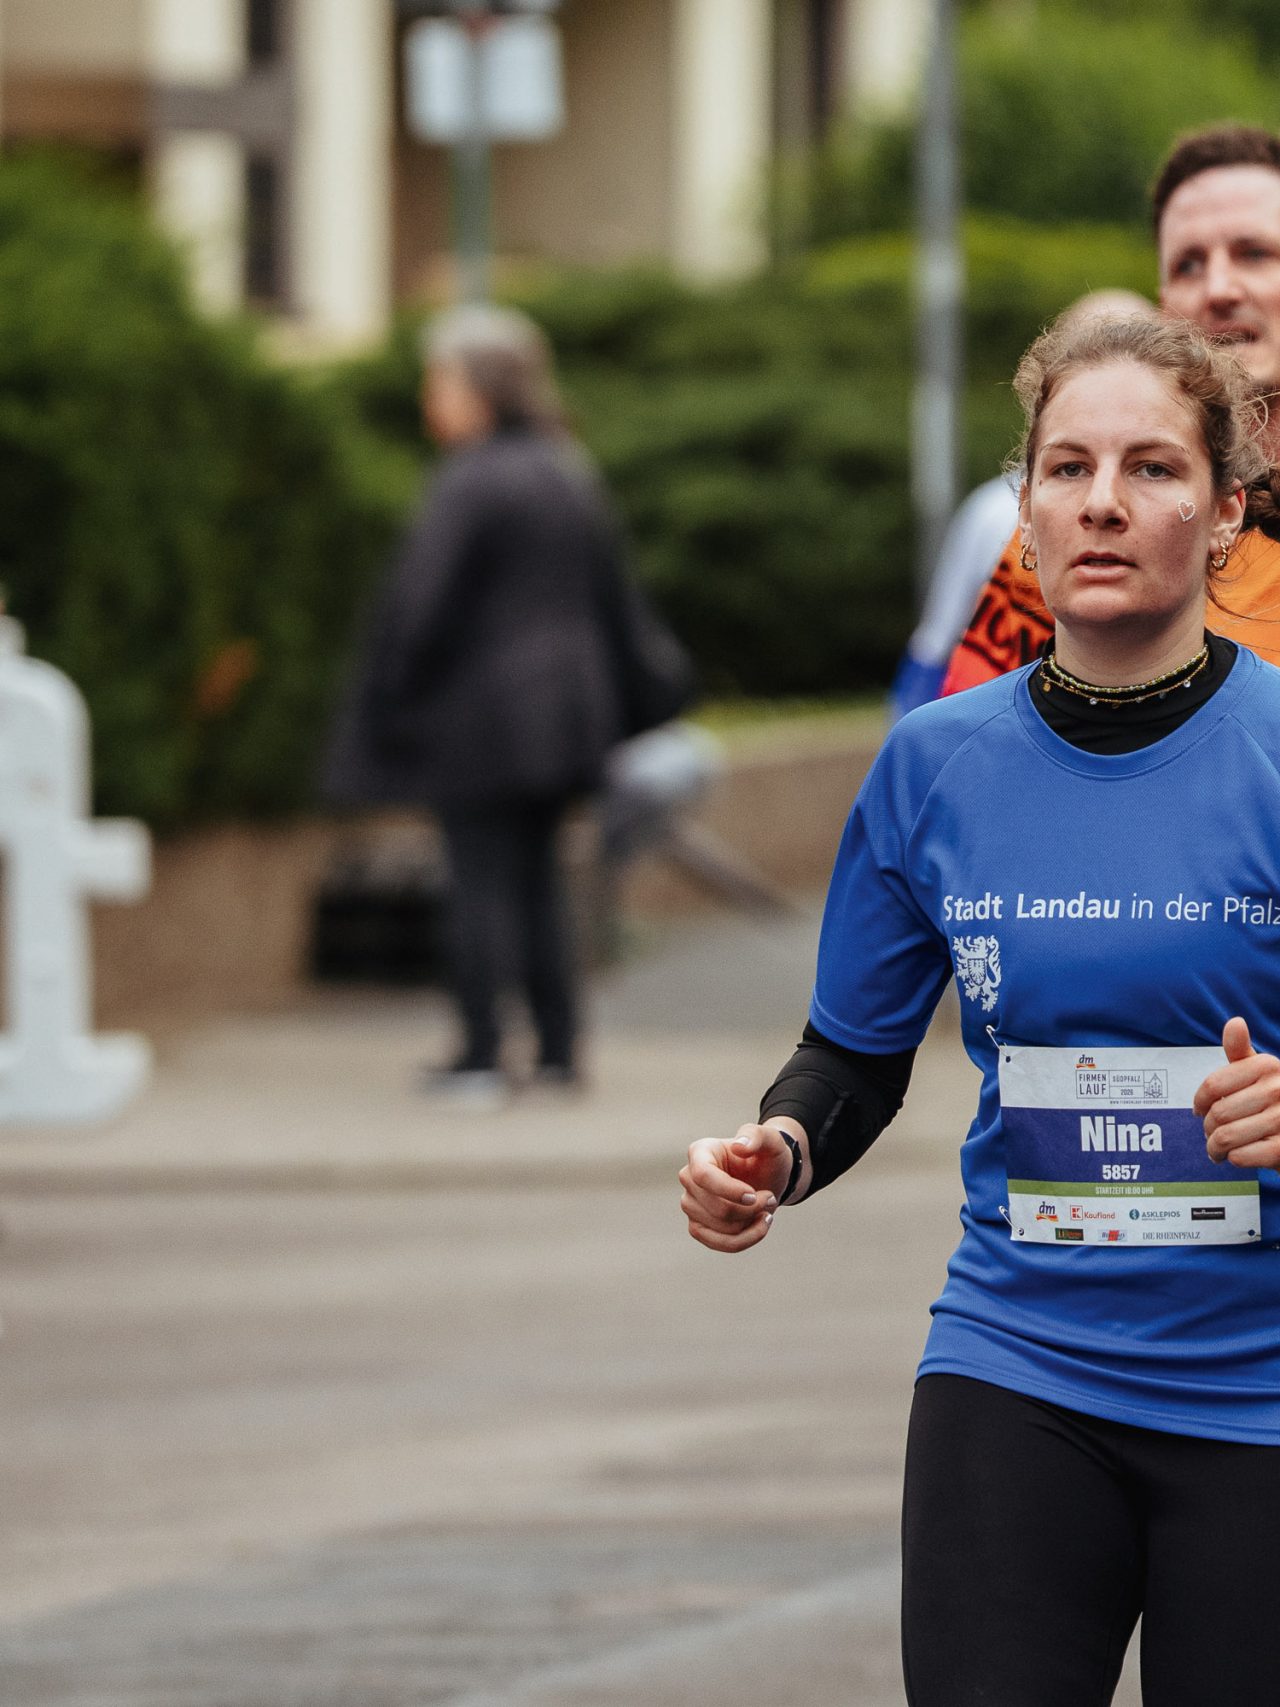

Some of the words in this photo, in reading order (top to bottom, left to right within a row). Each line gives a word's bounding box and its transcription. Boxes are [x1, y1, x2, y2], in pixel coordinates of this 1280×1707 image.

[943, 891, 1003, 922] Stadt
[1016, 891, 1121, 921] Landau
[1130, 892, 1154, 920] in
[1165, 893, 1212, 923] der
[1079, 1073, 1107, 1082] FIRMEN
[1079, 1083, 1107, 1096] LAUF
[1080, 1115, 1163, 1152] Nina
[1102, 1164, 1141, 1180] 5857
[1095, 1186, 1124, 1195] STARTZEIT
[1141, 1186, 1154, 1195] UHR
[1038, 1201, 1056, 1215] dm
[1084, 1211, 1116, 1220] Kaufland
[1142, 1231, 1156, 1241] DIE
[1156, 1231, 1201, 1241] RHEINPFALZ
